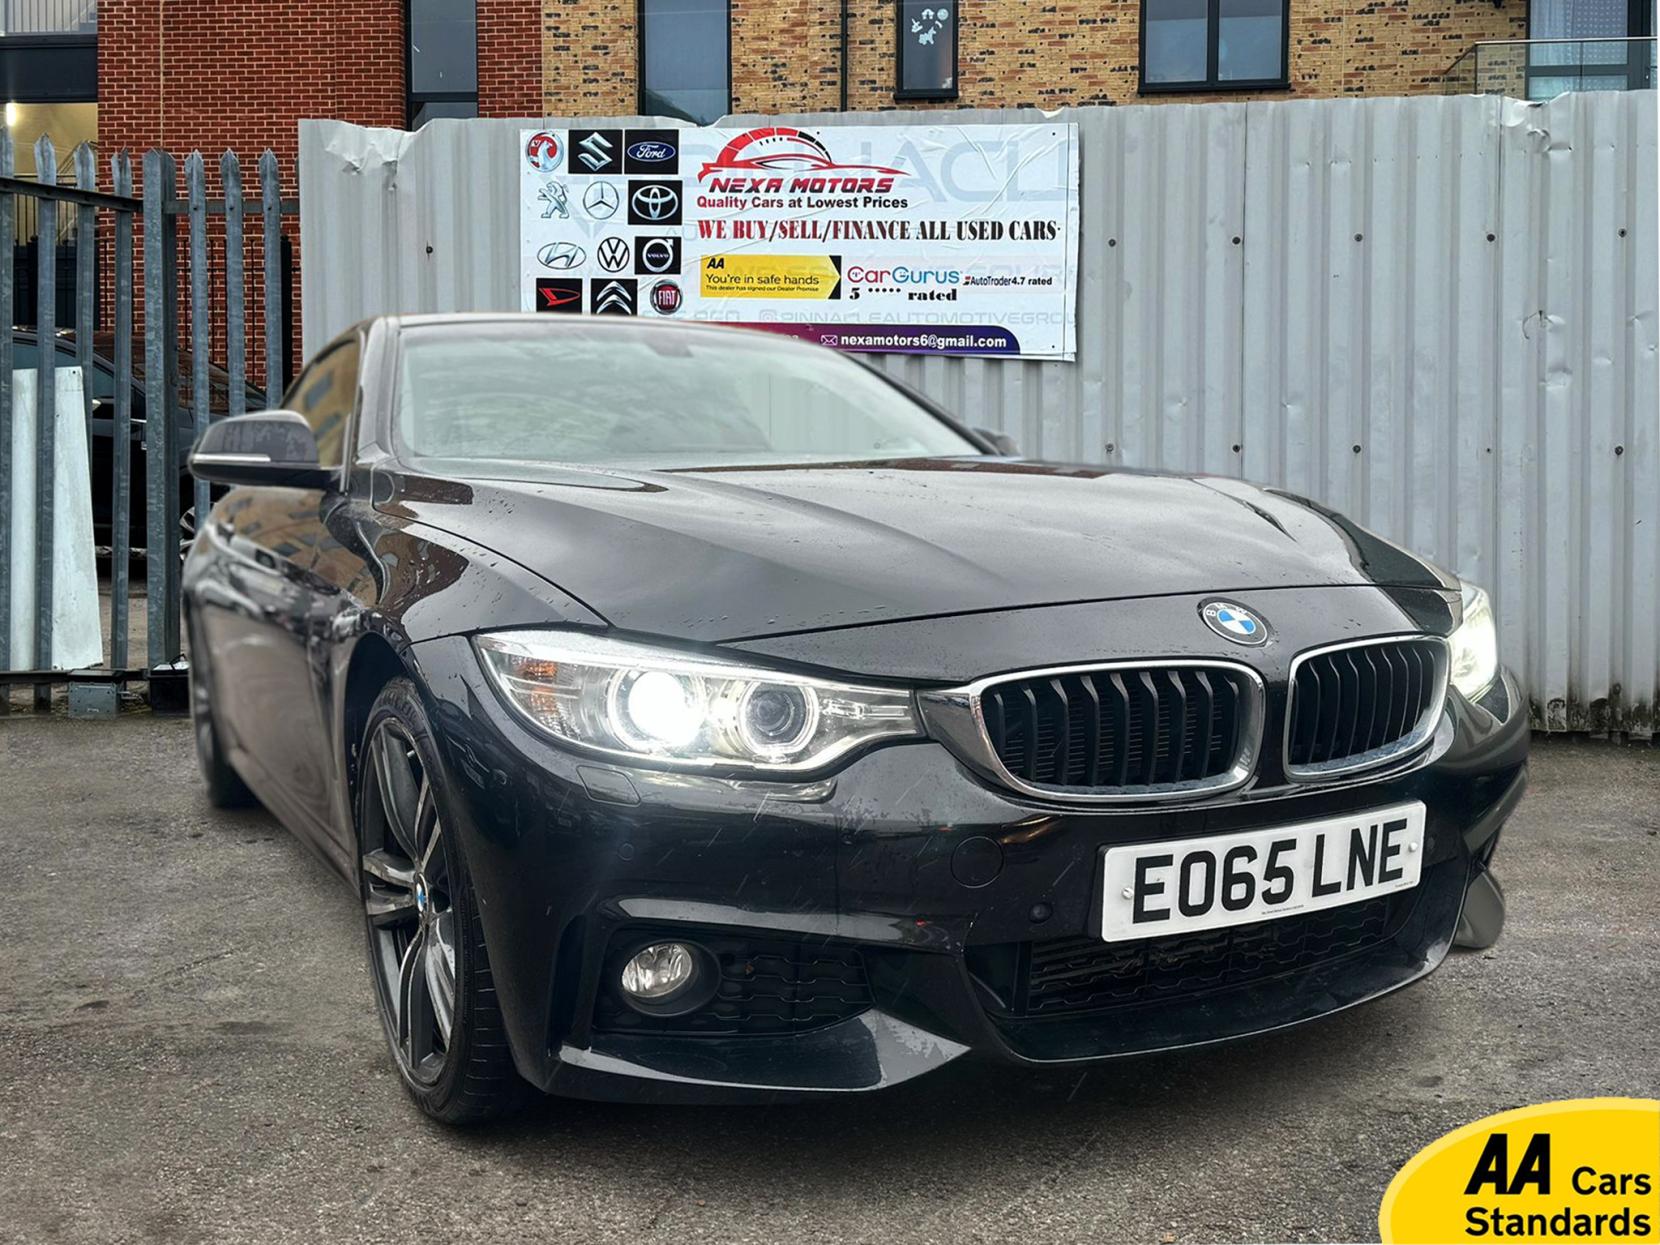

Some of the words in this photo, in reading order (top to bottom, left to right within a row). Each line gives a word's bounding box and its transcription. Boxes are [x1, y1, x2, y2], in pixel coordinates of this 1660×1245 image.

[636, 144, 665, 158] Ford
[709, 177, 783, 194] NEXA
[789, 177, 895, 194] MOTORS
[697, 196, 746, 210] Quality
[751, 196, 783, 208] Cars
[789, 197, 803, 208] at
[807, 196, 858, 208] Lowest
[863, 196, 908, 209] Prices
[697, 220, 726, 239] WE
[732, 220, 911, 243] BUY/SELL/FINANCE
[916, 220, 950, 240] ALL
[956, 220, 1004, 240] USED
[1009, 220, 1057, 240] CARS
[707, 258, 725, 269] AA
[706, 274, 741, 284] You're
[744, 274, 754, 284] in
[757, 274, 781, 284] safe
[784, 274, 820, 285] hands
[847, 266, 960, 284] CarGurus
[1028, 277, 1052, 286] rated
[658, 290, 676, 305] FIAT
[850, 287, 860, 300] 5
[908, 288, 957, 301] rated
[841, 335, 1007, 349] nexamotors6@gmail.com
[1312, 818, 1408, 898] LNE
